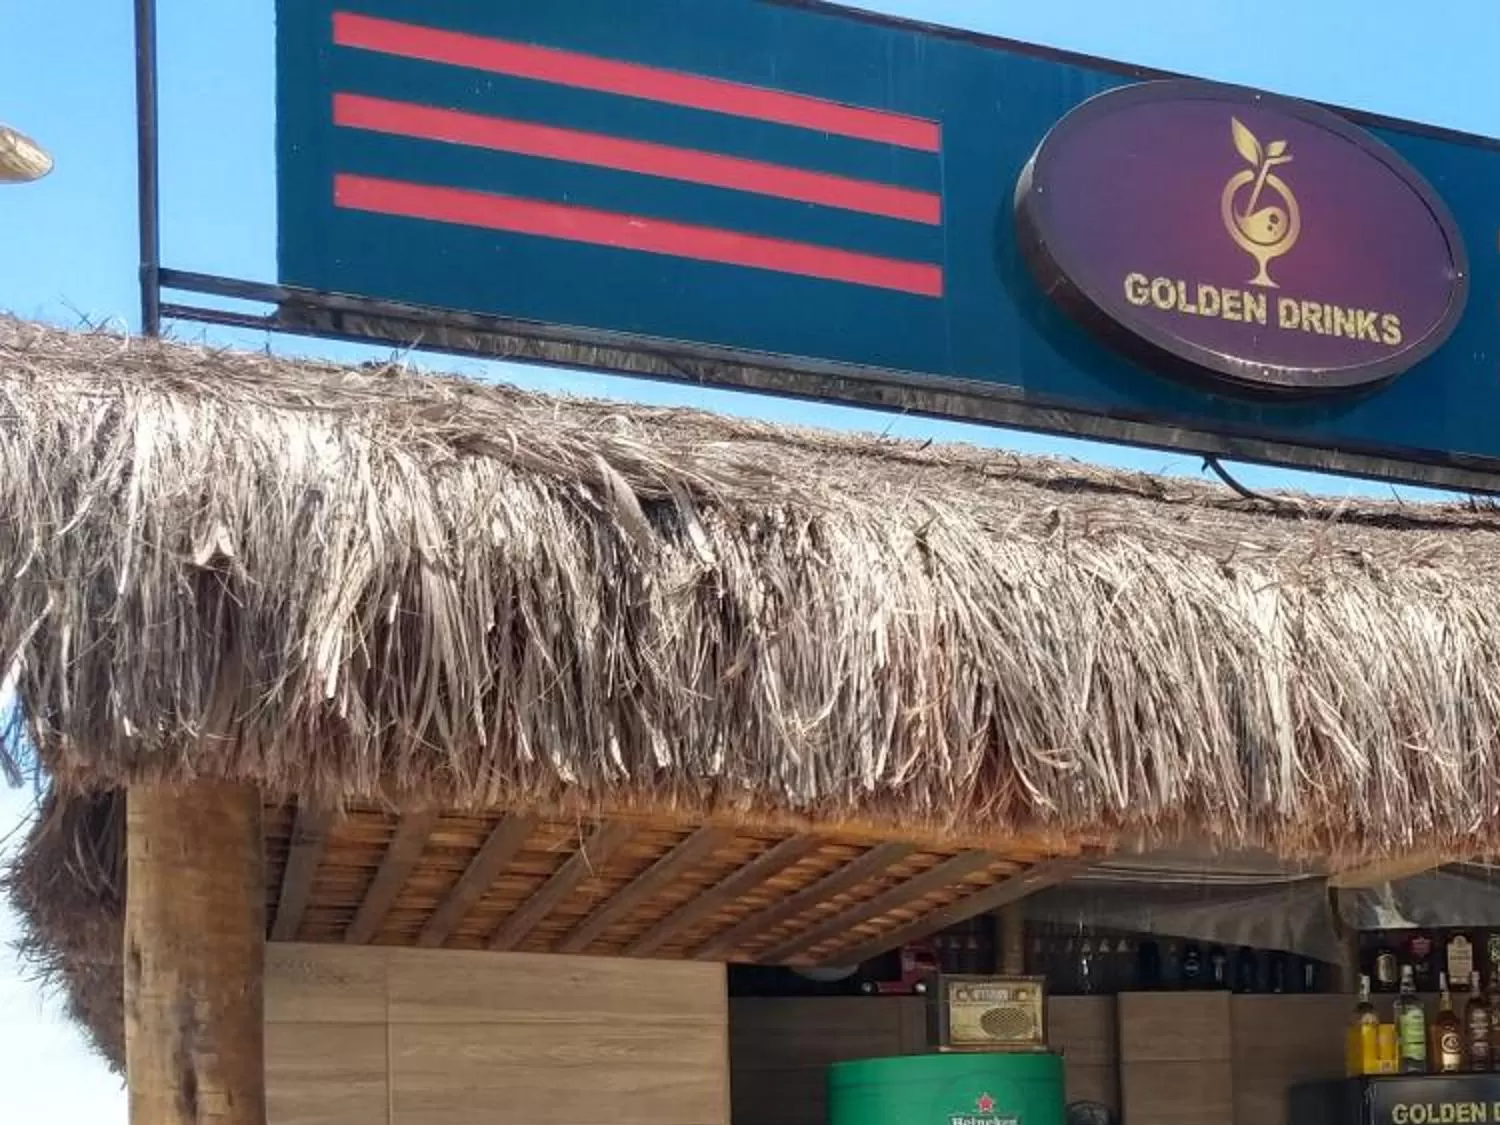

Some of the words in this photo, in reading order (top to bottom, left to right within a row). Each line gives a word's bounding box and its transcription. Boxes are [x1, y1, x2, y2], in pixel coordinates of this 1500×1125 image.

[1123, 272, 1267, 324] GOLDEN
[1278, 299, 1402, 345] DRINKS
[1392, 1102, 1487, 1125] GOLDEN
